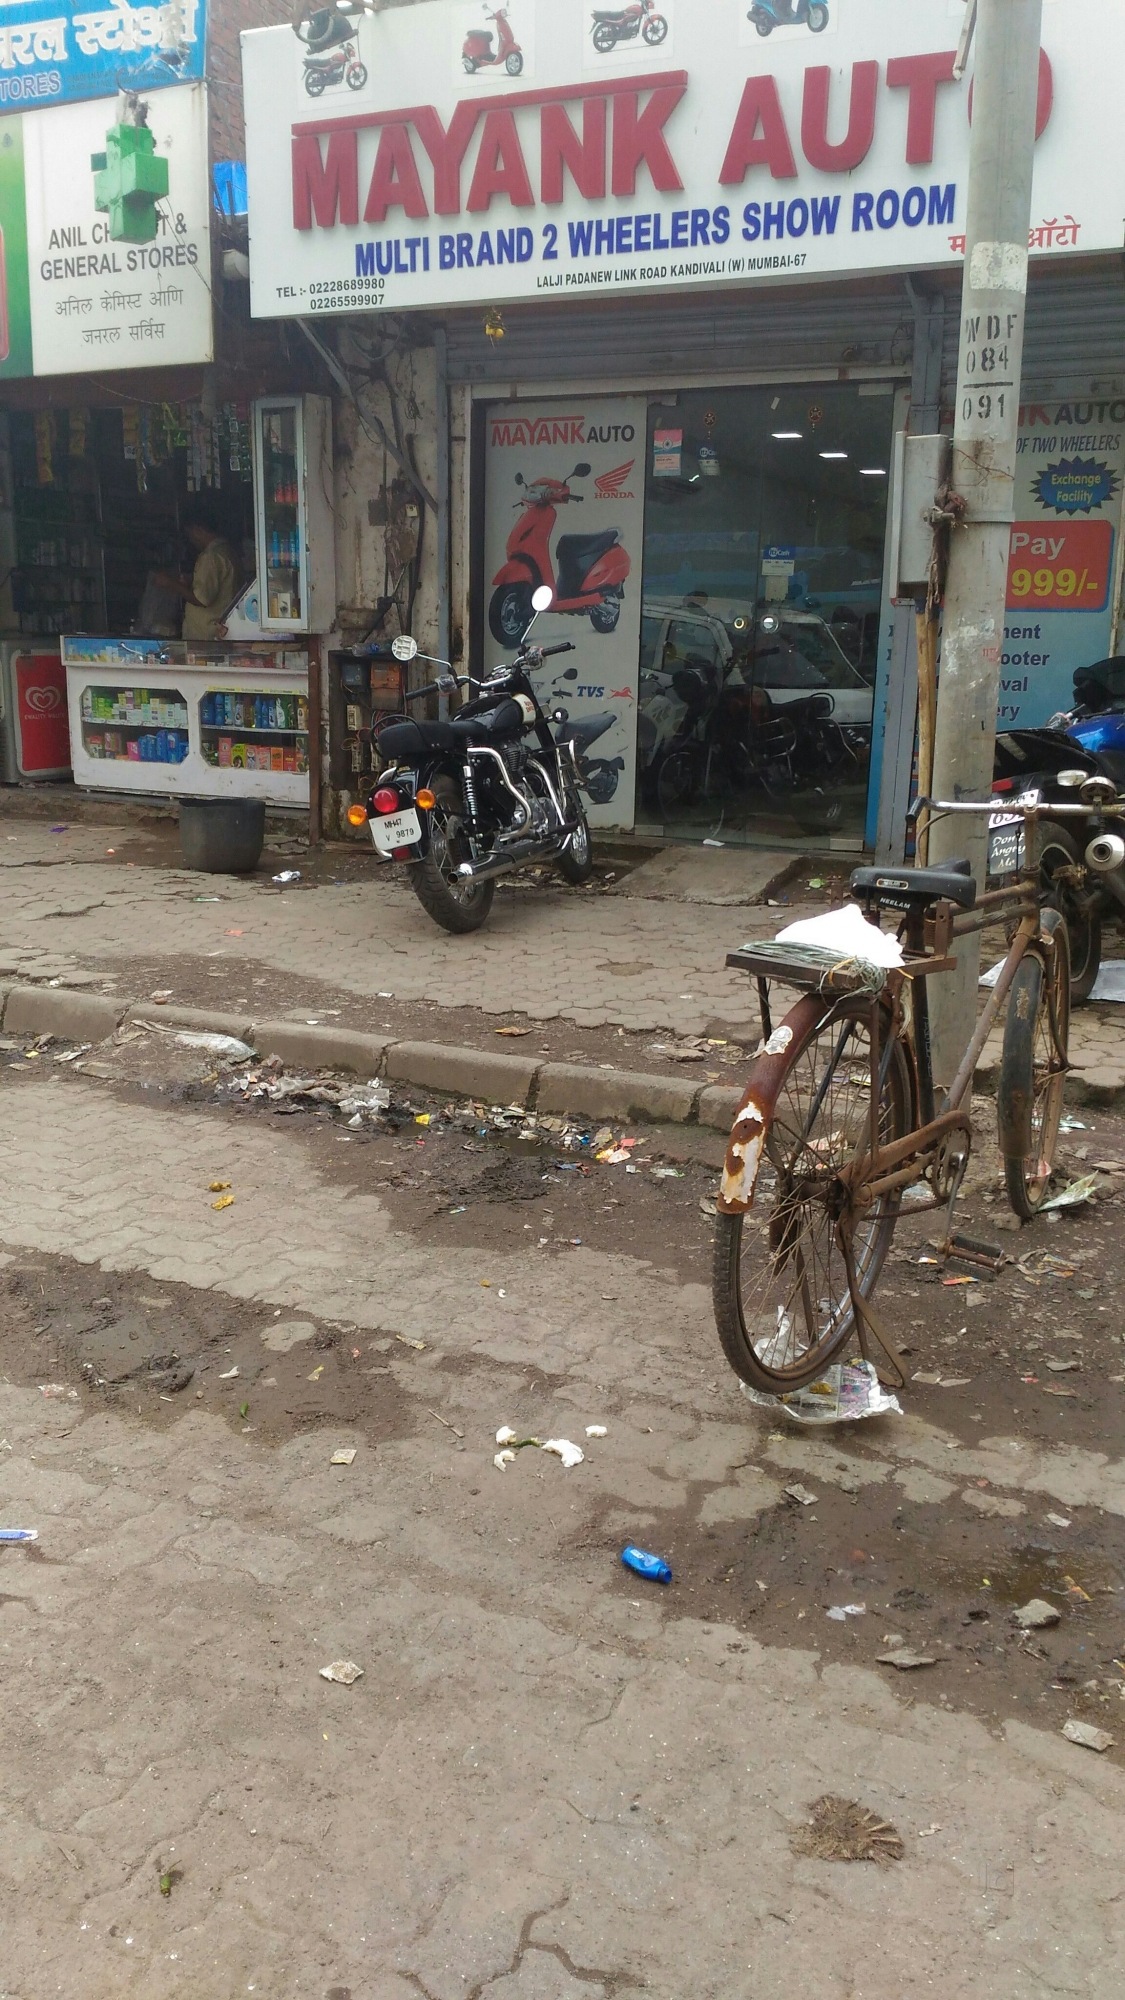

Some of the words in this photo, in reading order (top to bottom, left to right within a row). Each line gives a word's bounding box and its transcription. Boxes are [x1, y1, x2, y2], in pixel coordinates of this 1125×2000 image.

[0, 71, 61, 101] TORES
[291, 69, 689, 231] MAYANK
[49, 226, 87, 250] ANIL
[174, 212, 188, 235] &
[355, 236, 430, 277] MULTI
[438, 226, 534, 271] BRAND
[541, 223, 558, 261] 2
[567, 205, 730, 258] WHEELERS
[741, 195, 841, 242] SHOW
[851, 183, 957, 232] ROOM
[40, 252, 122, 281] GENERAL
[126, 243, 199, 272] STORES
[537, 273, 563, 288] LALJI
[614, 268, 637, 282] LINK
[639, 266, 667, 280] ROAD
[670, 261, 726, 277] KANDIVALI
[728, 258, 745, 273] (W)
[747, 253, 807, 271] MUMBAI-67
[55, 295, 92, 316] अनिल
[100, 290, 142, 312] केमिस्ट
[150, 285, 184, 307] आणि
[276, 286, 297, 298] TEL
[309, 278, 386, 295] 02228689980
[310, 293, 385, 310] 02265599907
[82, 327, 121, 345] जनरल
[129, 318, 165, 341] सर्विस
[966, 345, 1009, 374] 084
[963, 393, 1005, 420] 091
[490, 416, 586, 447] MAYANK
[586, 424, 636, 444] AUTO
[1032, 436, 1057, 453] TWO
[1060, 434, 1122, 452] WHEELERS
[1051, 472, 1101, 487] Exchange
[594, 491, 636, 499] HONDA
[1056, 490, 1094, 504] Facility
[1010, 532, 1066, 560] Pay
[1000, 650, 1050, 666] ooter
[576, 685, 605, 698] TVS
[395, 827, 415, 838] 9879
[879, 897, 911, 909] NEELAM
